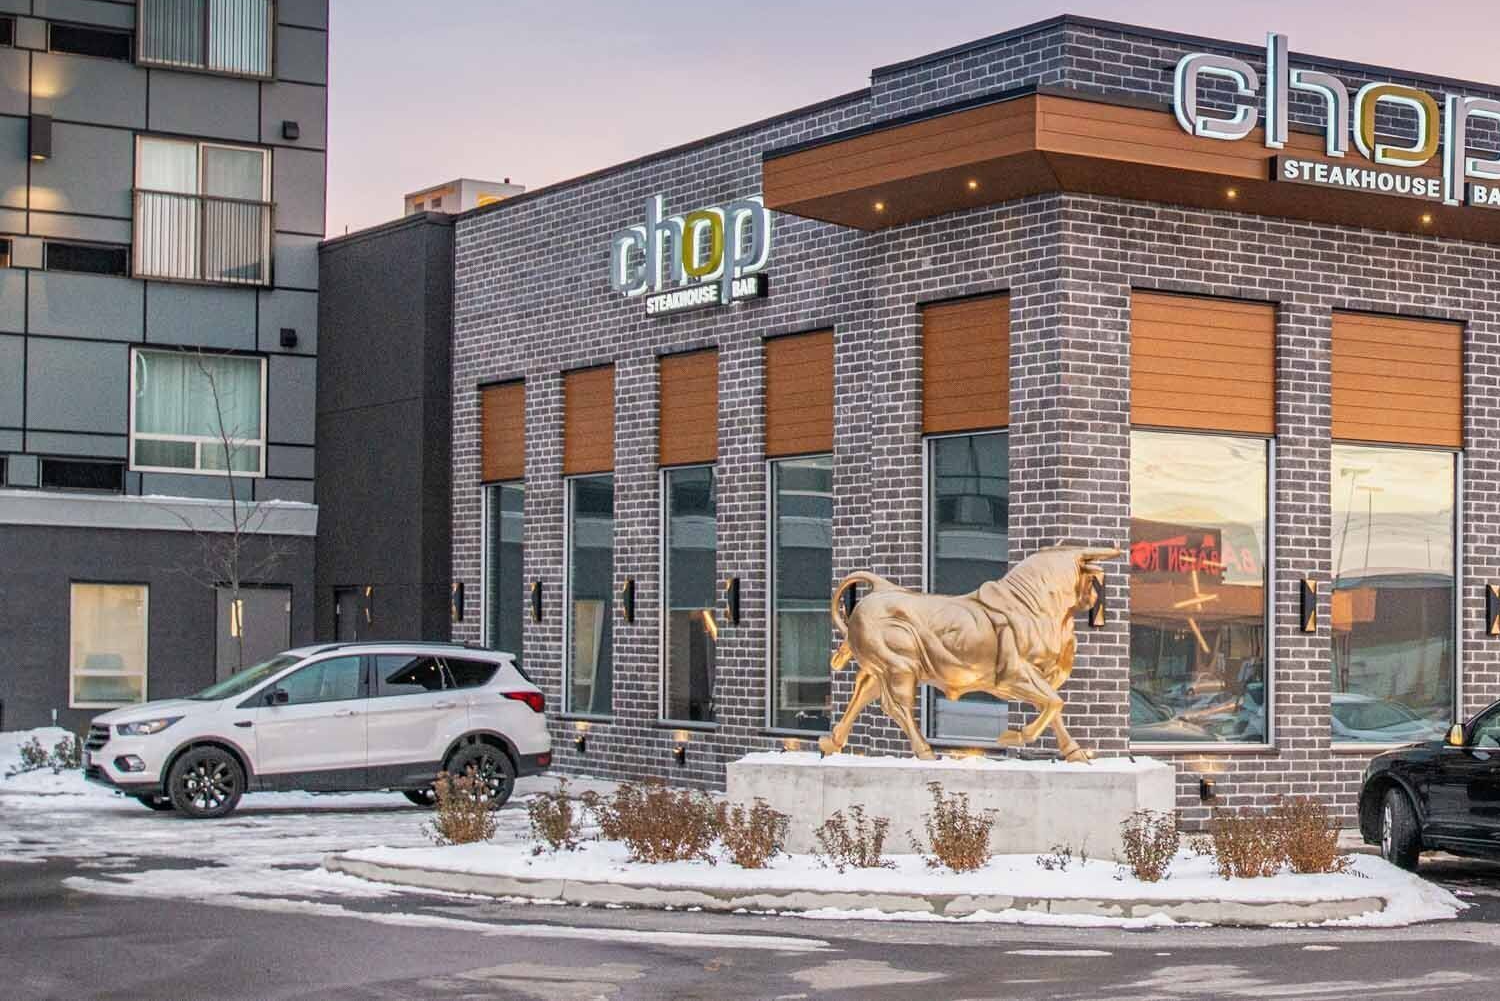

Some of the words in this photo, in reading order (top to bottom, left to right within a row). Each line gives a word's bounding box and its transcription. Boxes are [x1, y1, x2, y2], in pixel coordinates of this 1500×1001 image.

[1283, 160, 1440, 197] STEAKHOUSE
[610, 194, 771, 305] chop
[646, 284, 718, 314] STEAKHOUSE
[731, 277, 758, 298] BAR
